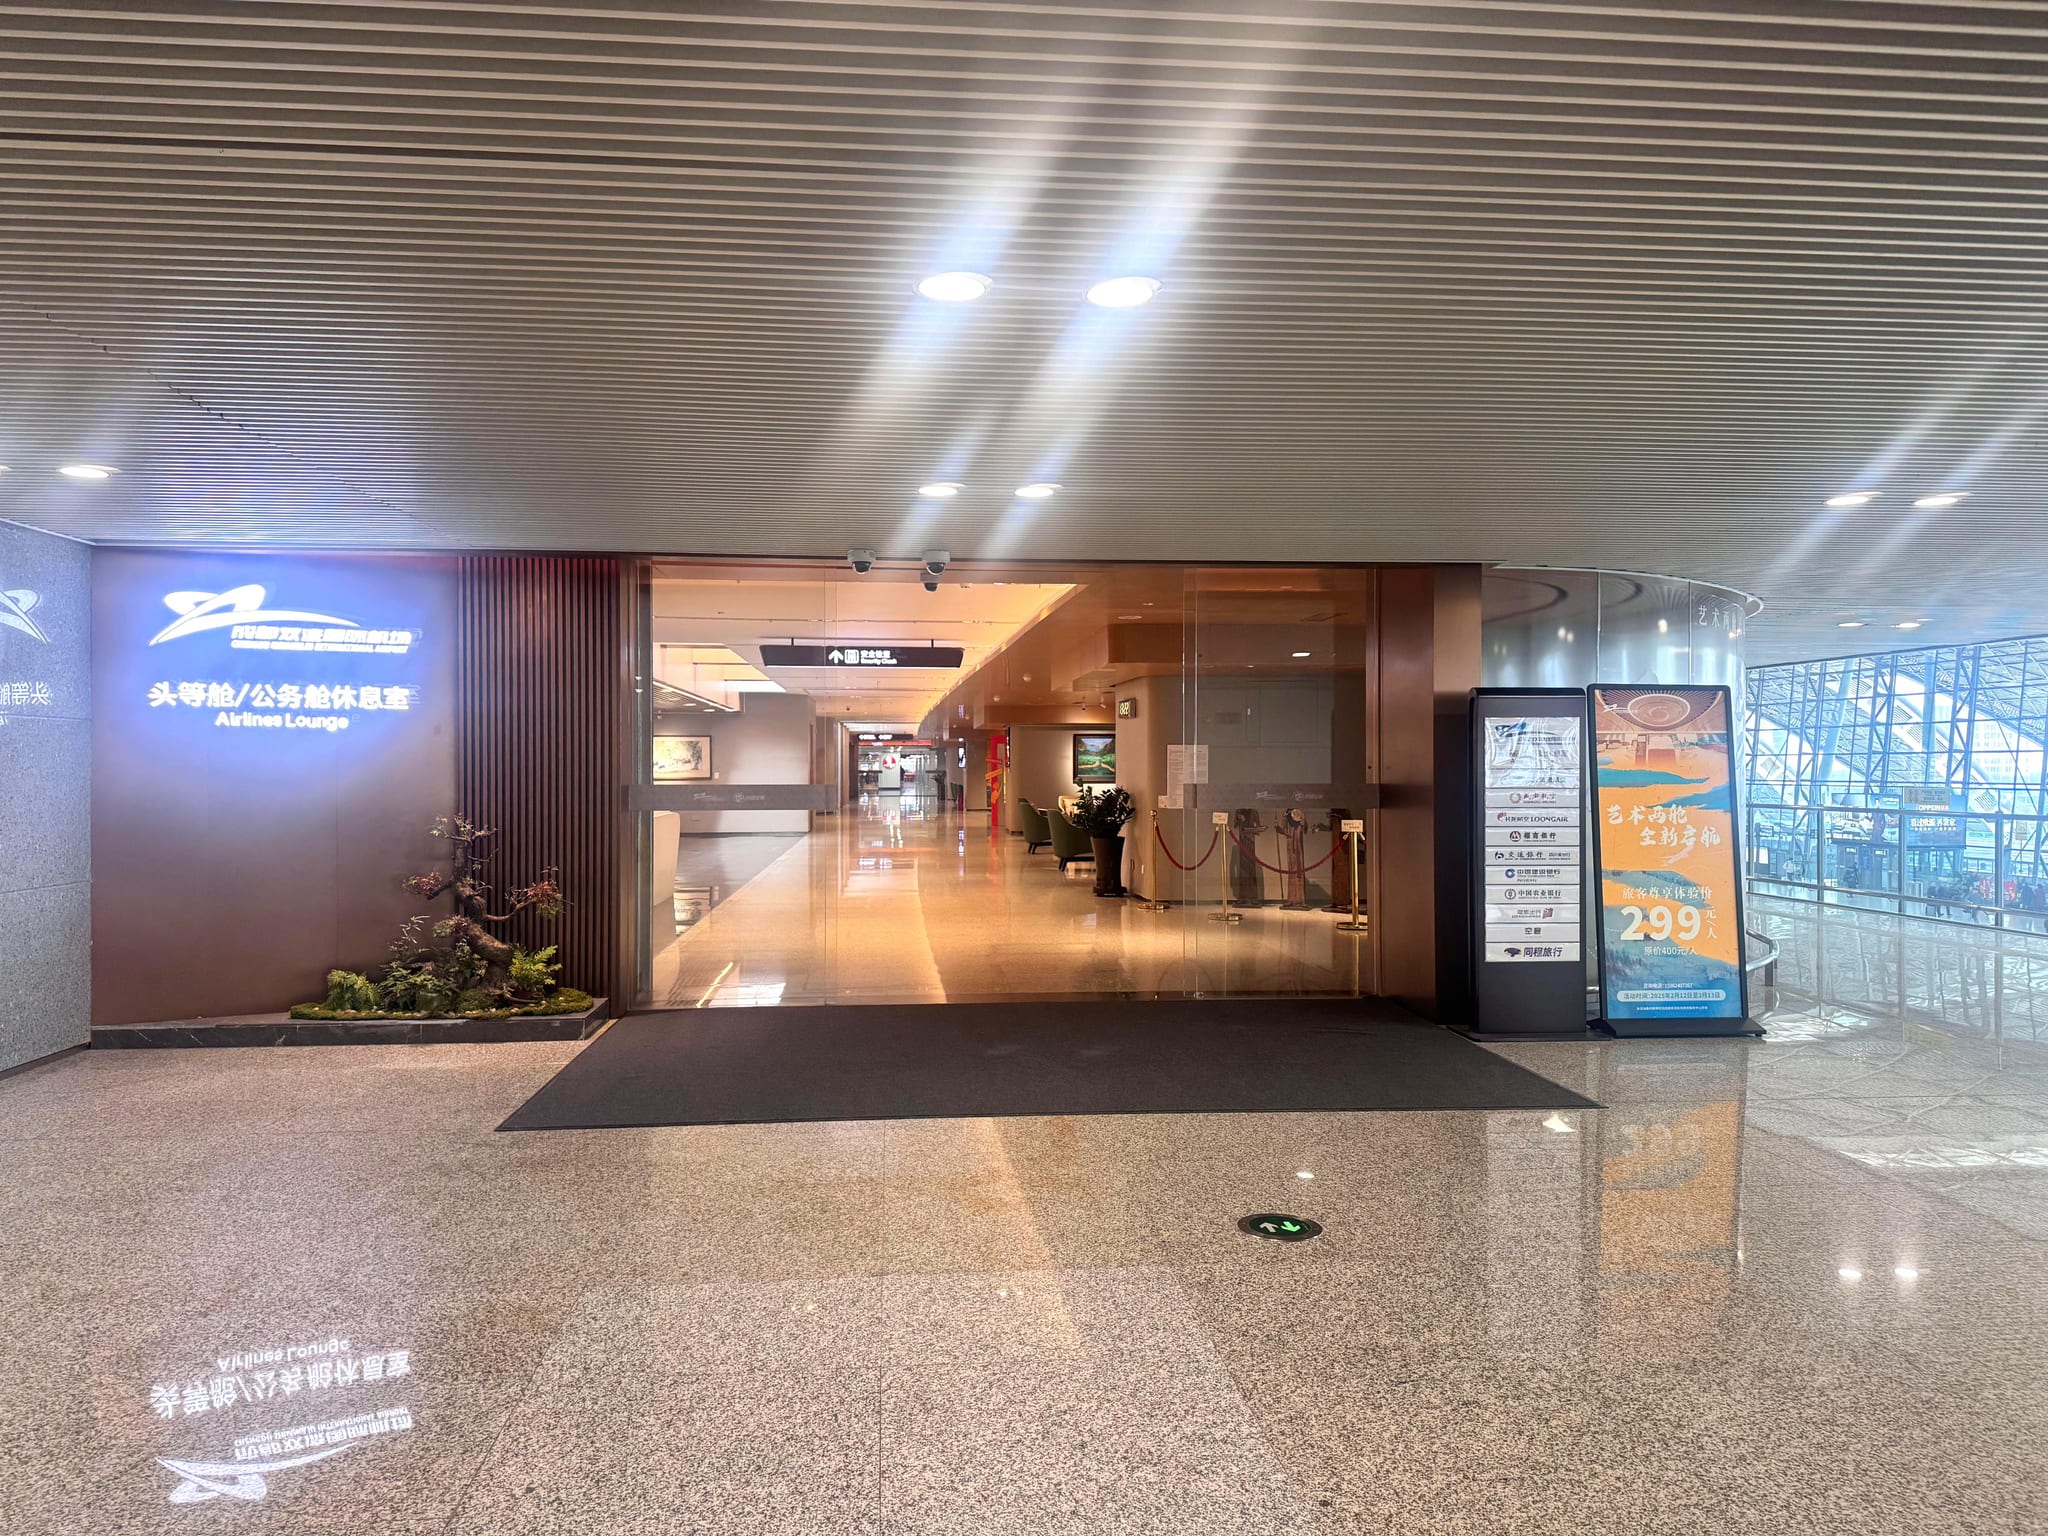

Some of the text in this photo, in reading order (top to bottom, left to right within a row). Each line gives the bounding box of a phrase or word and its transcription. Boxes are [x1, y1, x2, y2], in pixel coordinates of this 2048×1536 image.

[147, 681, 411, 711] 头等舱/公务舱休息室
[214, 711, 350, 733] Airlines Lounge
[1606, 804, 1688, 825] 艺术两舱
[1640, 824, 1721, 850] 全新启航
[1518, 889, 1561, 897] 中国农业银行
[1622, 886, 1713, 900] 旅客尊享体验价
[1620, 905, 1701, 941] 299
[1523, 947, 1564, 958] 同程旅行
[1644, 946, 1698, 956] 原价400元/人
